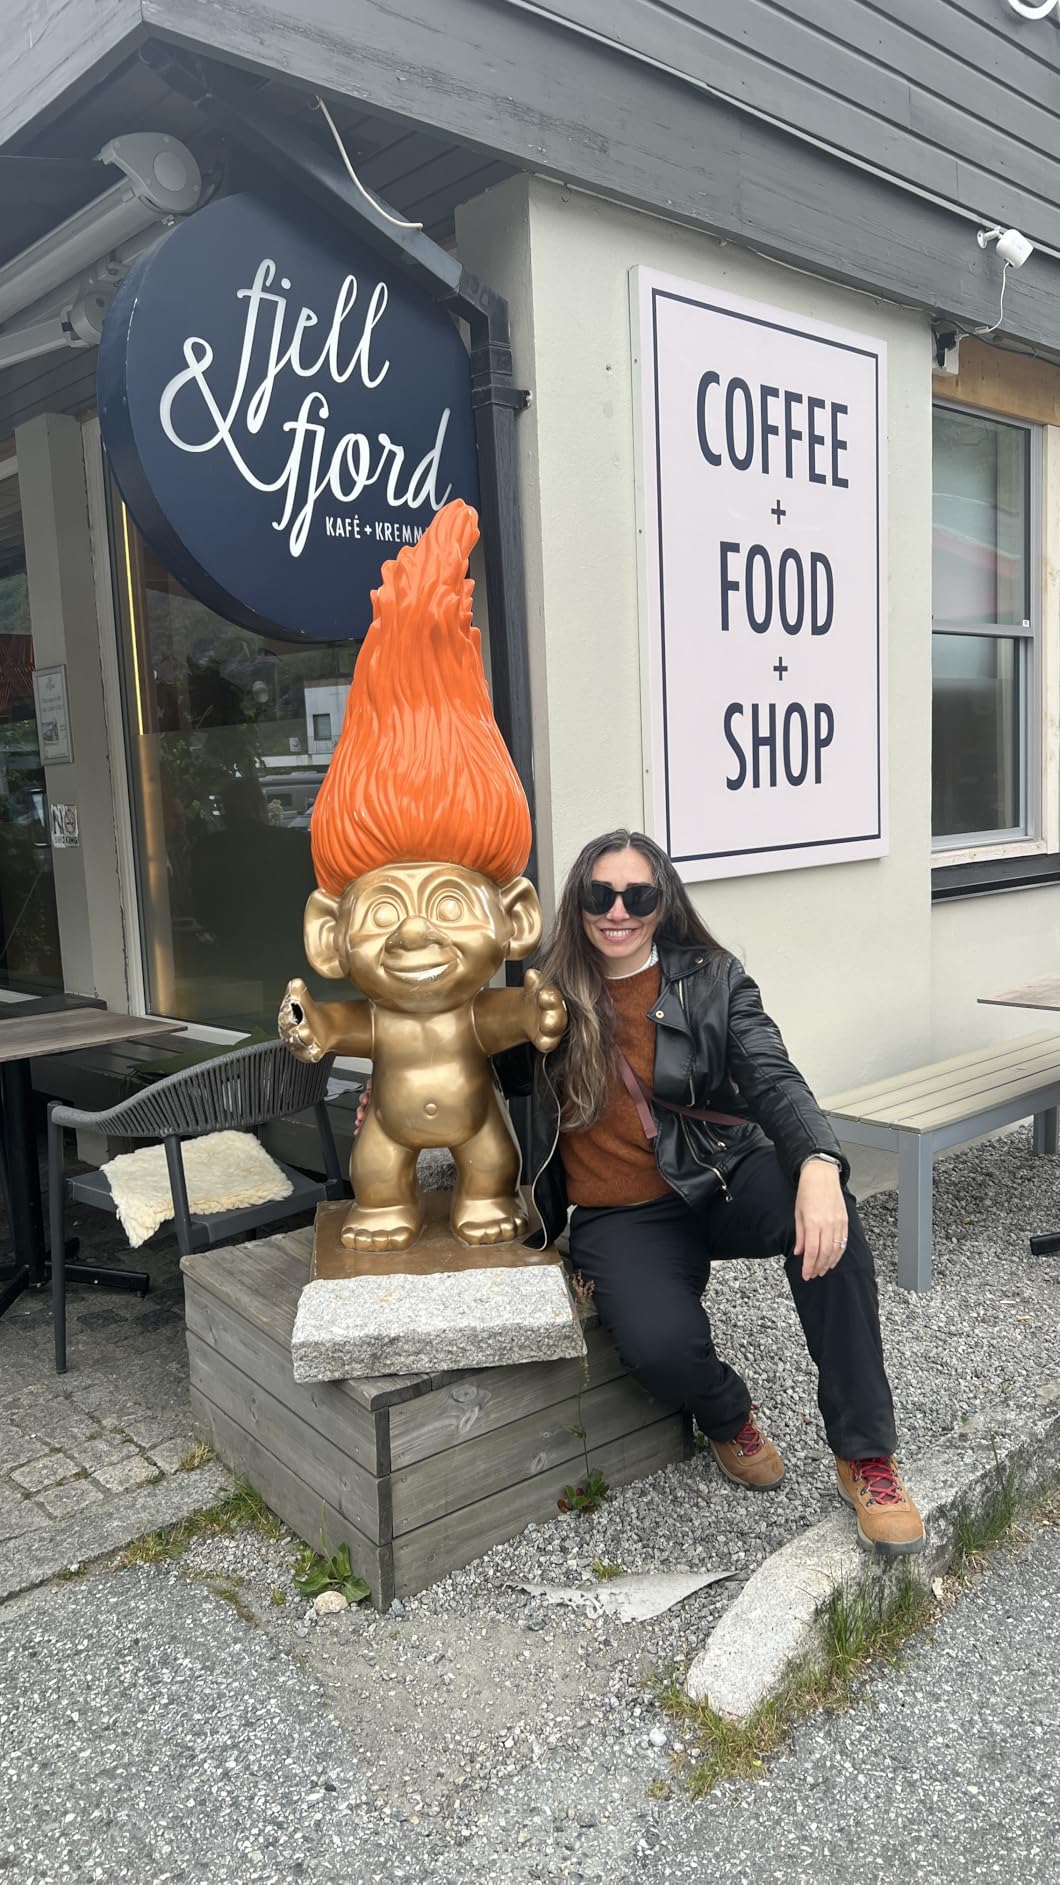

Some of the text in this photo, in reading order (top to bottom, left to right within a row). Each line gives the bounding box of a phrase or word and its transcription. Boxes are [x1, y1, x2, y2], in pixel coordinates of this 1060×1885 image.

[226, 258, 390, 434] fjell
[159, 336, 452, 558] & fjord
[697, 370, 849, 488] COFFEE
[364, 525, 373, 535] +
[375, 521, 425, 543] KREMM
[771, 500, 787, 525] +
[719, 541, 834, 636] FOOD
[773, 656, 788, 681] +
[723, 702, 835, 791] SHOP
